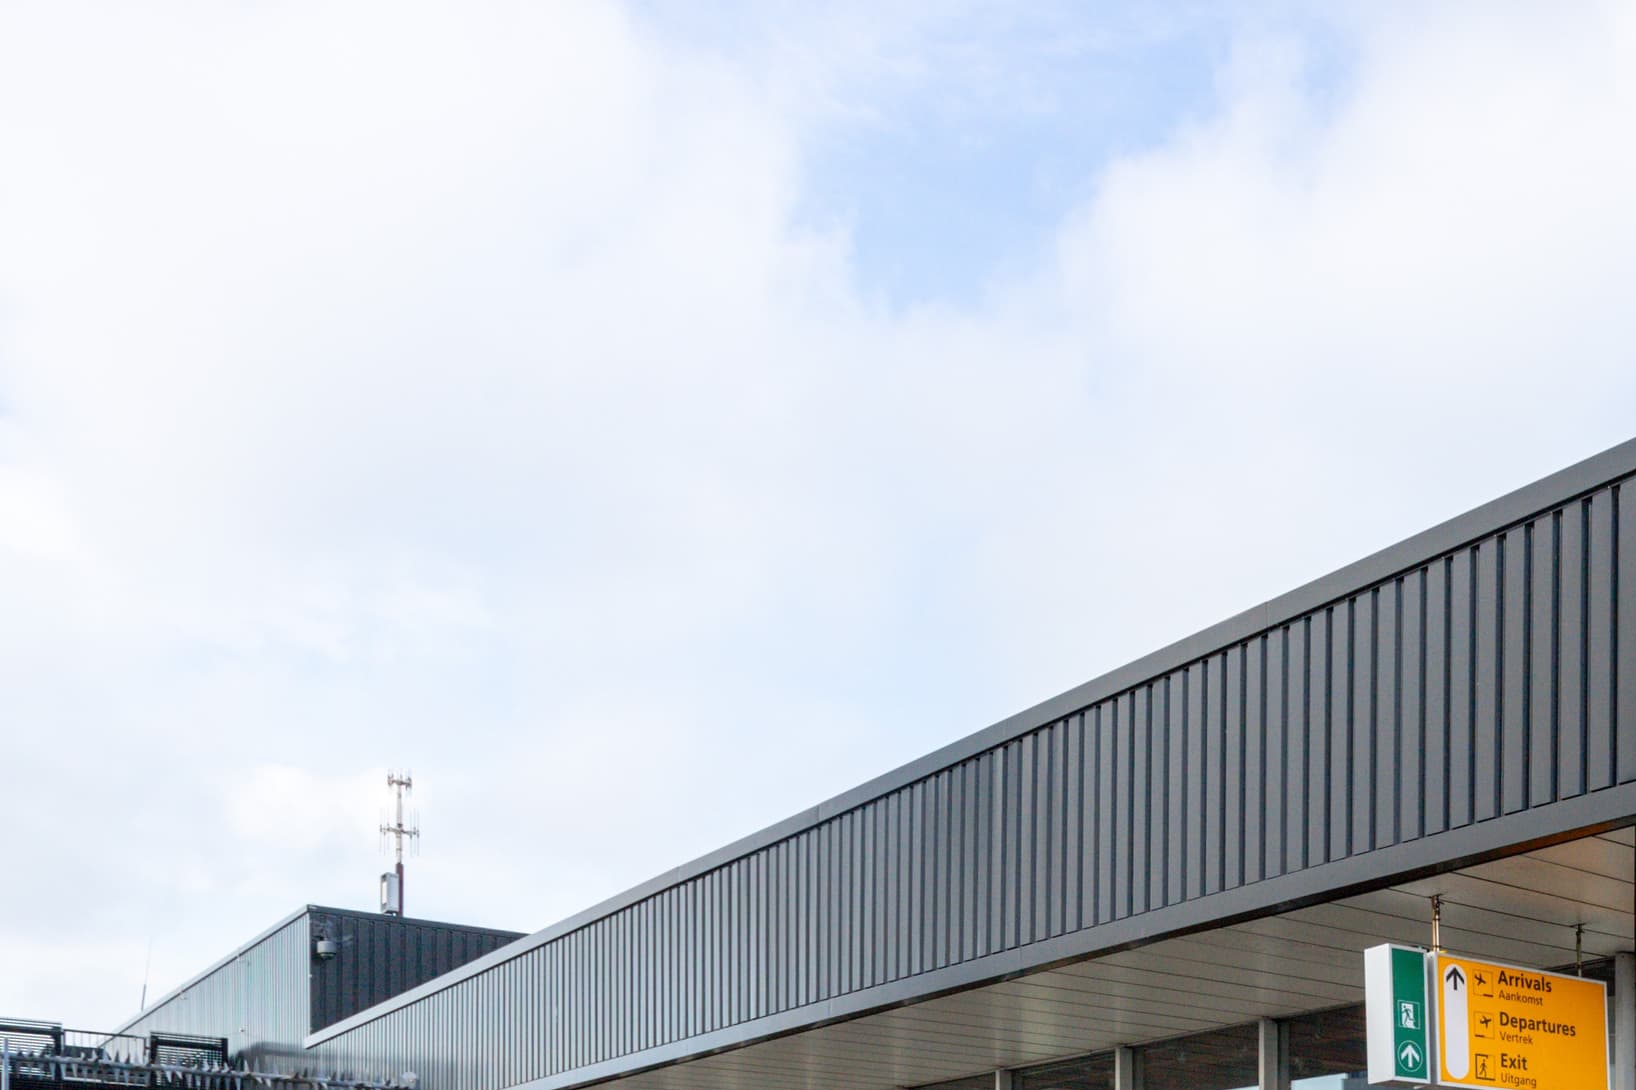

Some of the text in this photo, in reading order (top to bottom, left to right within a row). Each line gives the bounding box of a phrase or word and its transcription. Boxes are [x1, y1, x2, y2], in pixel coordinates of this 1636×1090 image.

[1498, 970, 1552, 993] Arrivals
[1499, 989, 1543, 1006] Aankomst
[1499, 1011, 1576, 1037] Departures
[1500, 1031, 1533, 1045] Vertrek
[1501, 1052, 1528, 1071] Exit
[1501, 1072, 1537, 1089] Uitgang
